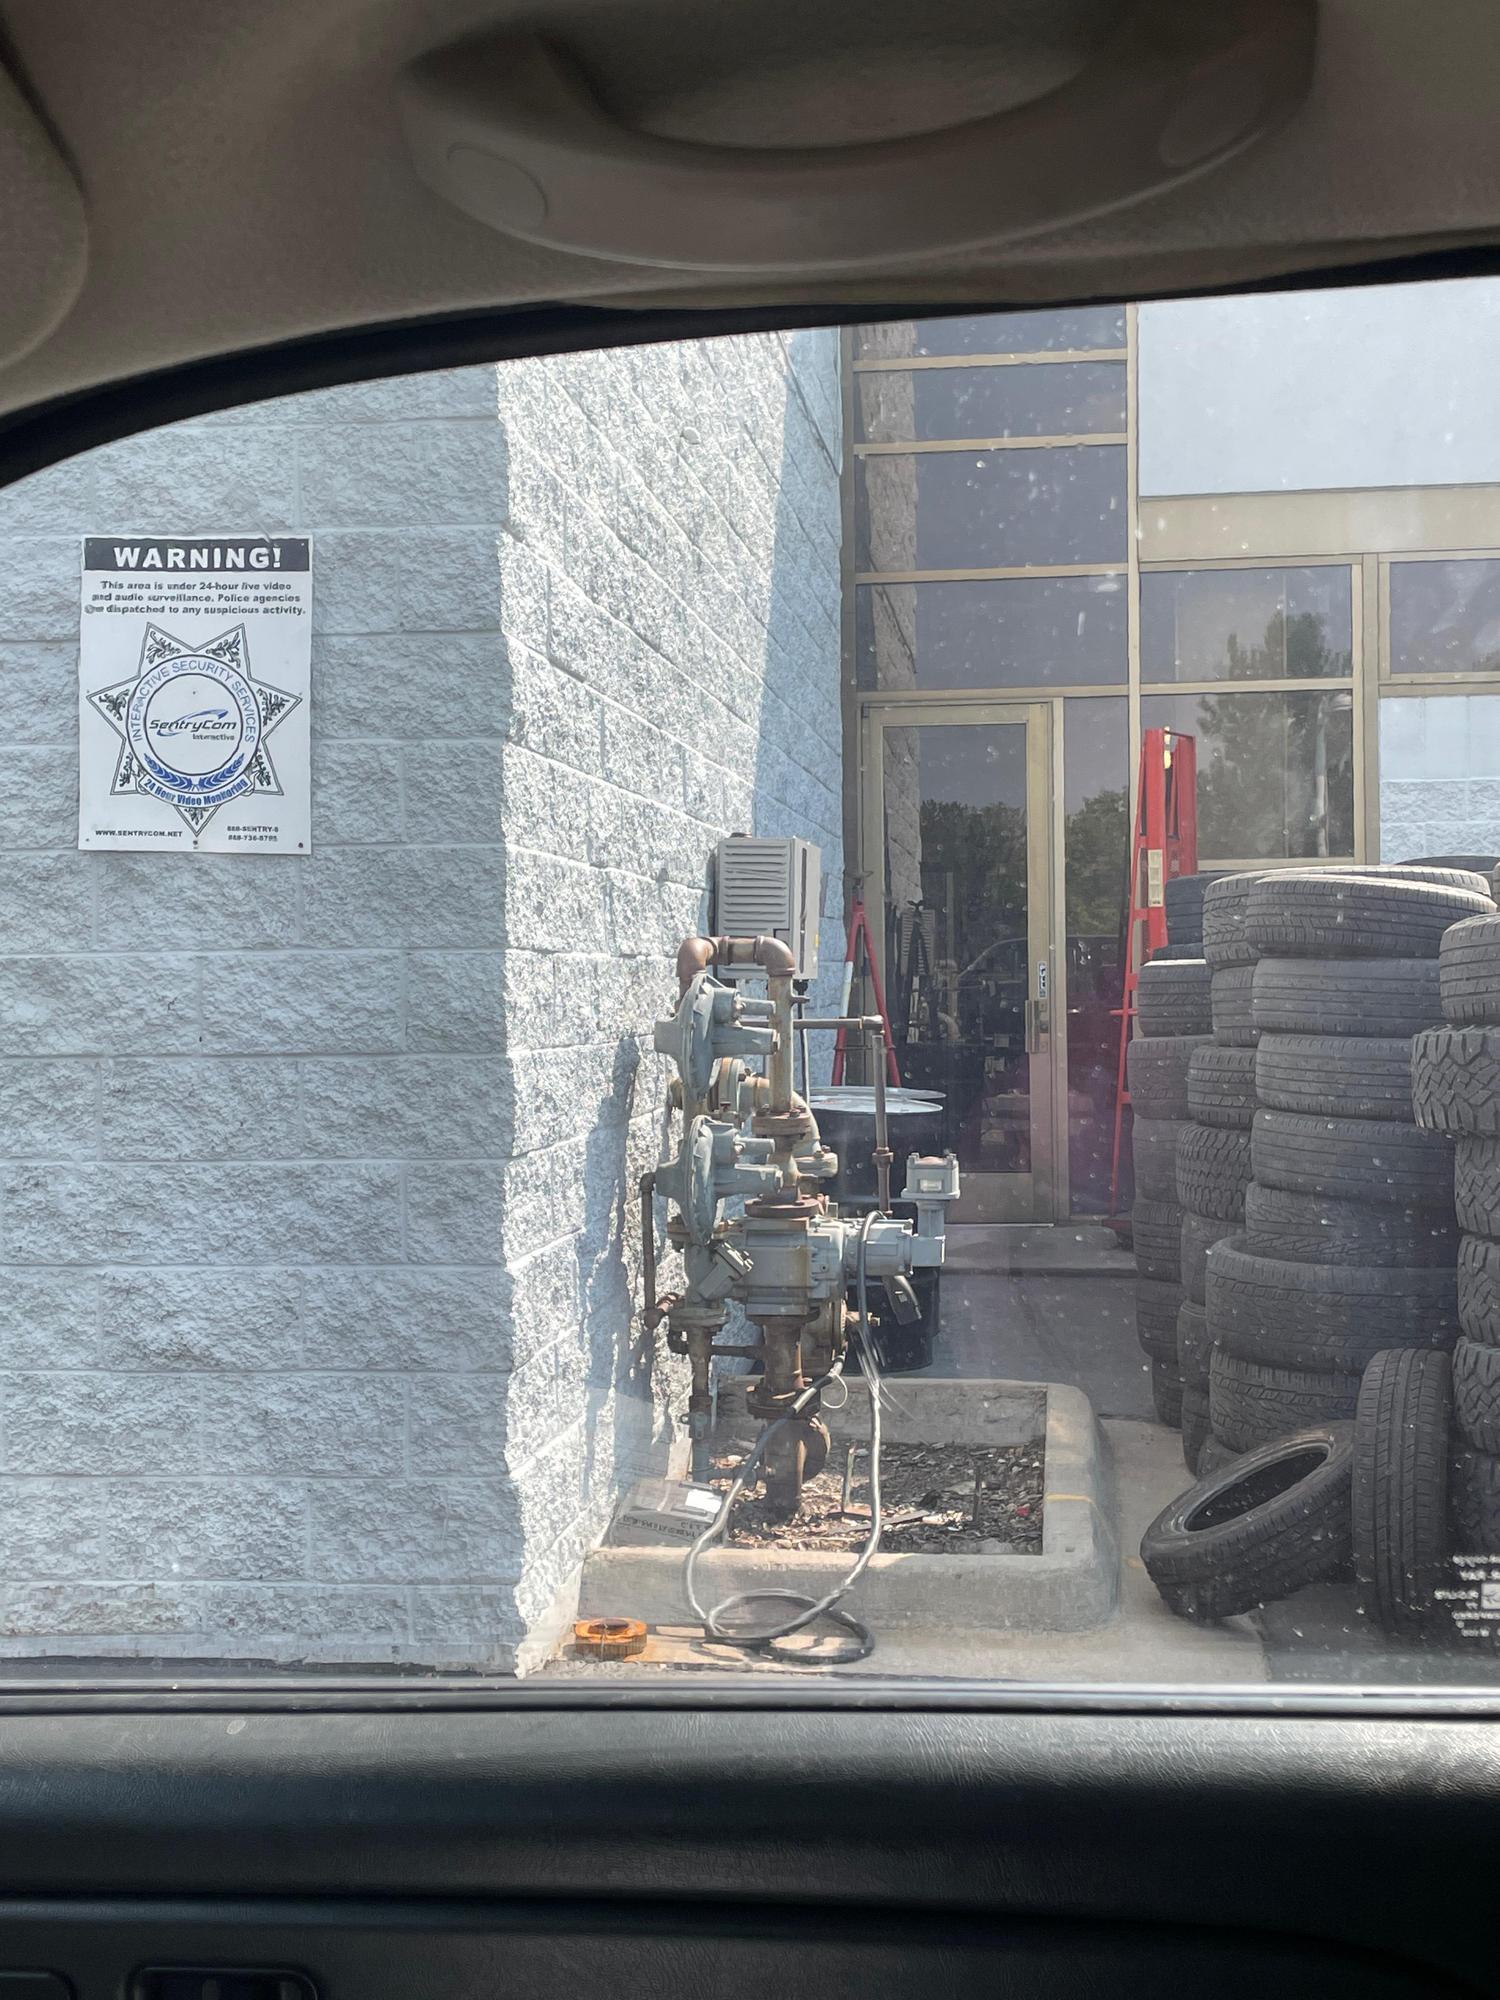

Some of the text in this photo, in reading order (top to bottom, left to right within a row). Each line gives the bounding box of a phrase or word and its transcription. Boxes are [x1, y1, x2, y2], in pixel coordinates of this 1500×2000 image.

[113, 546, 282, 569] WARNING!
[100, 580, 292, 590] This area is under 24-hour live video
[92, 593, 301, 604] and audio surveillance. Police agencies
[106, 604, 165, 615] dispatched
[169, 605, 179, 614] to
[182, 606, 201, 616] any
[204, 606, 260, 616] suspicious
[262, 606, 306, 616] activity.
[130, 659, 256, 744] INTERACTIVE SECURITY SERVICES
[149, 719, 237, 733] SentryCom
[144, 777, 250, 806] 24 Hour Video Monitoring
[95, 830, 183, 838] WWW.SENTRYCOM.NET
